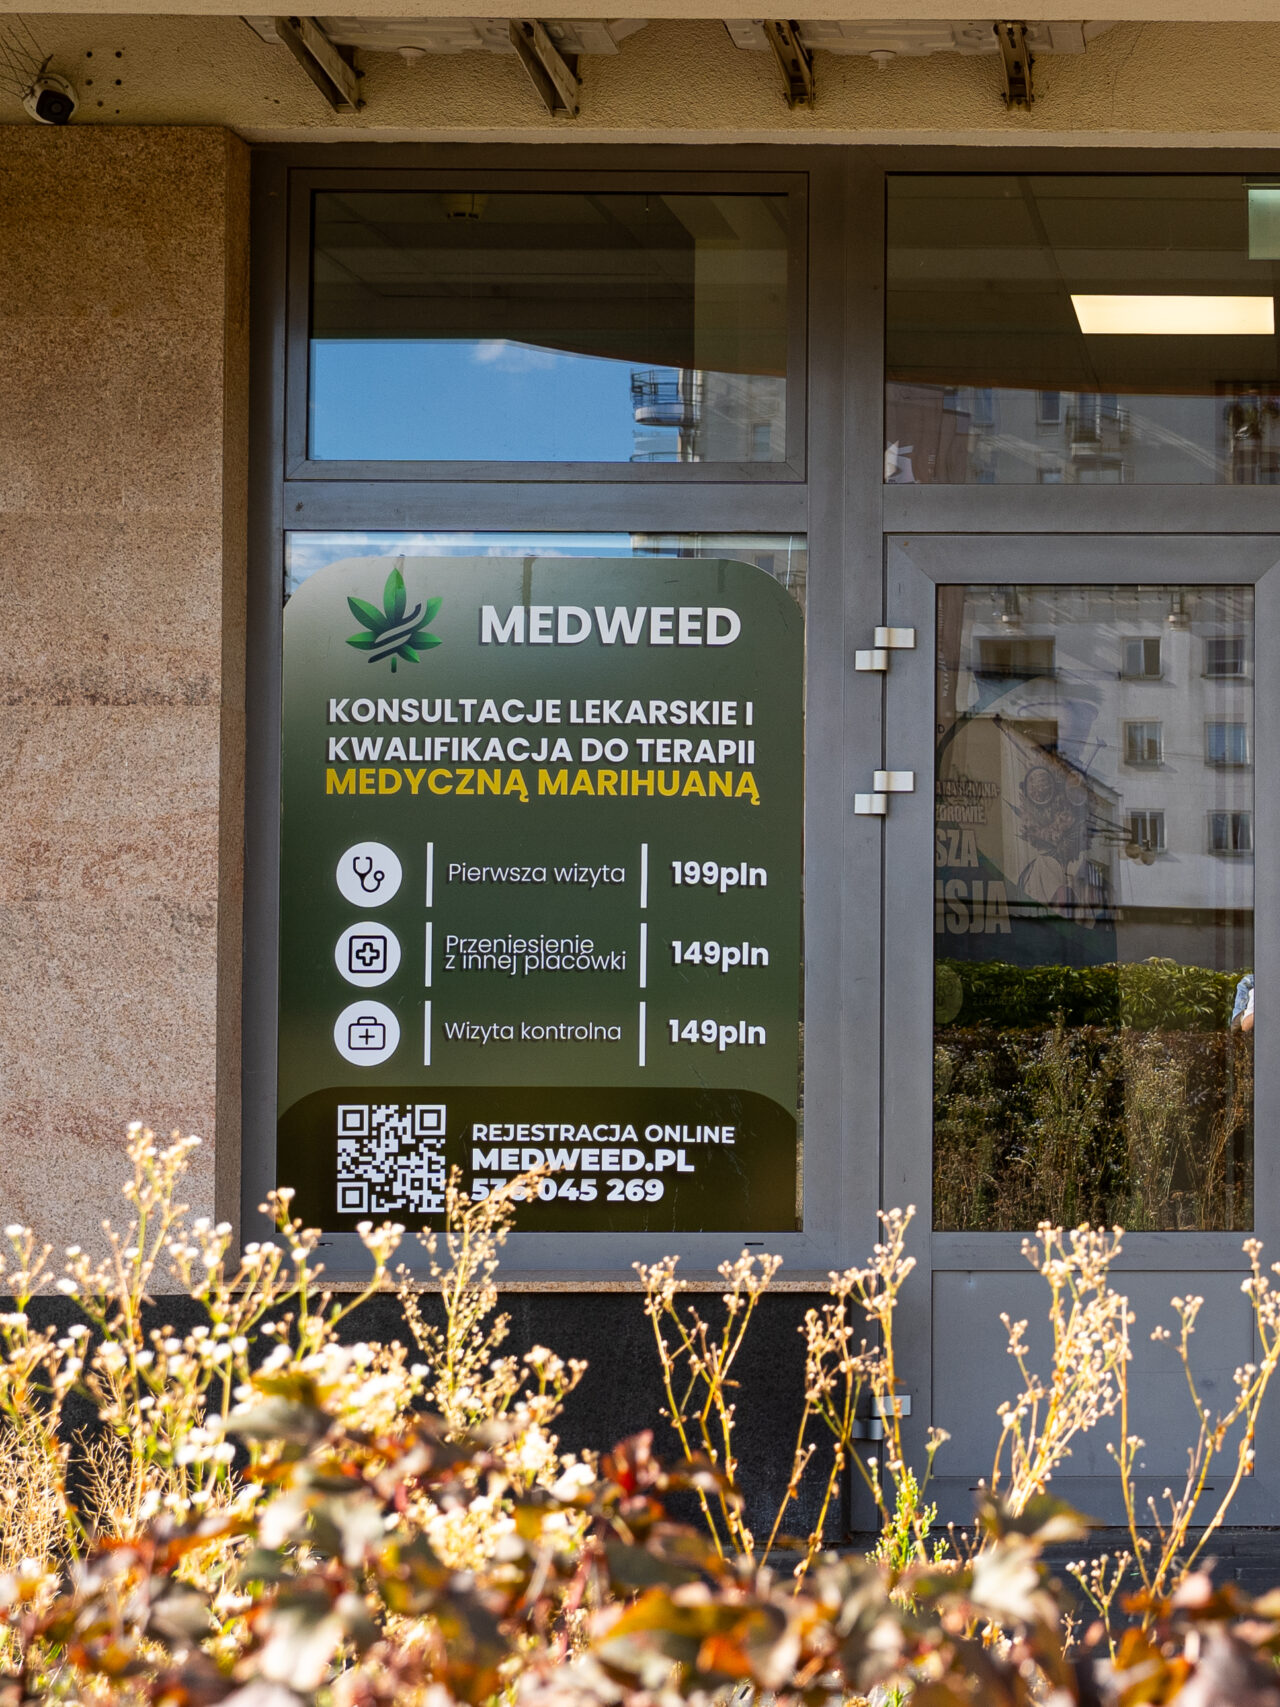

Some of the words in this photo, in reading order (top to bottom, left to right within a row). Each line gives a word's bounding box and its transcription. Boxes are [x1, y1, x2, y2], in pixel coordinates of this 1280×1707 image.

[480, 604, 742, 646] MEDWEED
[328, 698, 562, 724] KONSULTACJE
[569, 699, 738, 726] LEKARSKIE
[746, 701, 754, 726] I
[328, 736, 574, 763] KWALIFIKACJA
[581, 737, 629, 763] DO
[636, 738, 755, 765] TERAPII
[326, 767, 530, 803] MEDYCZNĄ
[537, 768, 761, 806] MARIHUANĄ
[447, 862, 547, 884] Pierwsza
[553, 863, 627, 888] wizyta
[671, 860, 768, 893] 199pln
[446, 934, 595, 954] Przeniesienie
[671, 940, 770, 973] 149pln
[445, 954, 456, 970] z
[462, 950, 518, 976] innej
[524, 950, 627, 976] placówki
[444, 1021, 515, 1045] Wizyta
[521, 1021, 622, 1040] kontrolna
[669, 1018, 767, 1051] 149pln
[472, 1123, 639, 1143] REJESTRACJA
[644, 1124, 736, 1144] ONLINE
[471, 1148, 695, 1172] MEDWEED.PL
[537, 1178, 598, 1202] 045
[606, 1178, 665, 1202] 269
